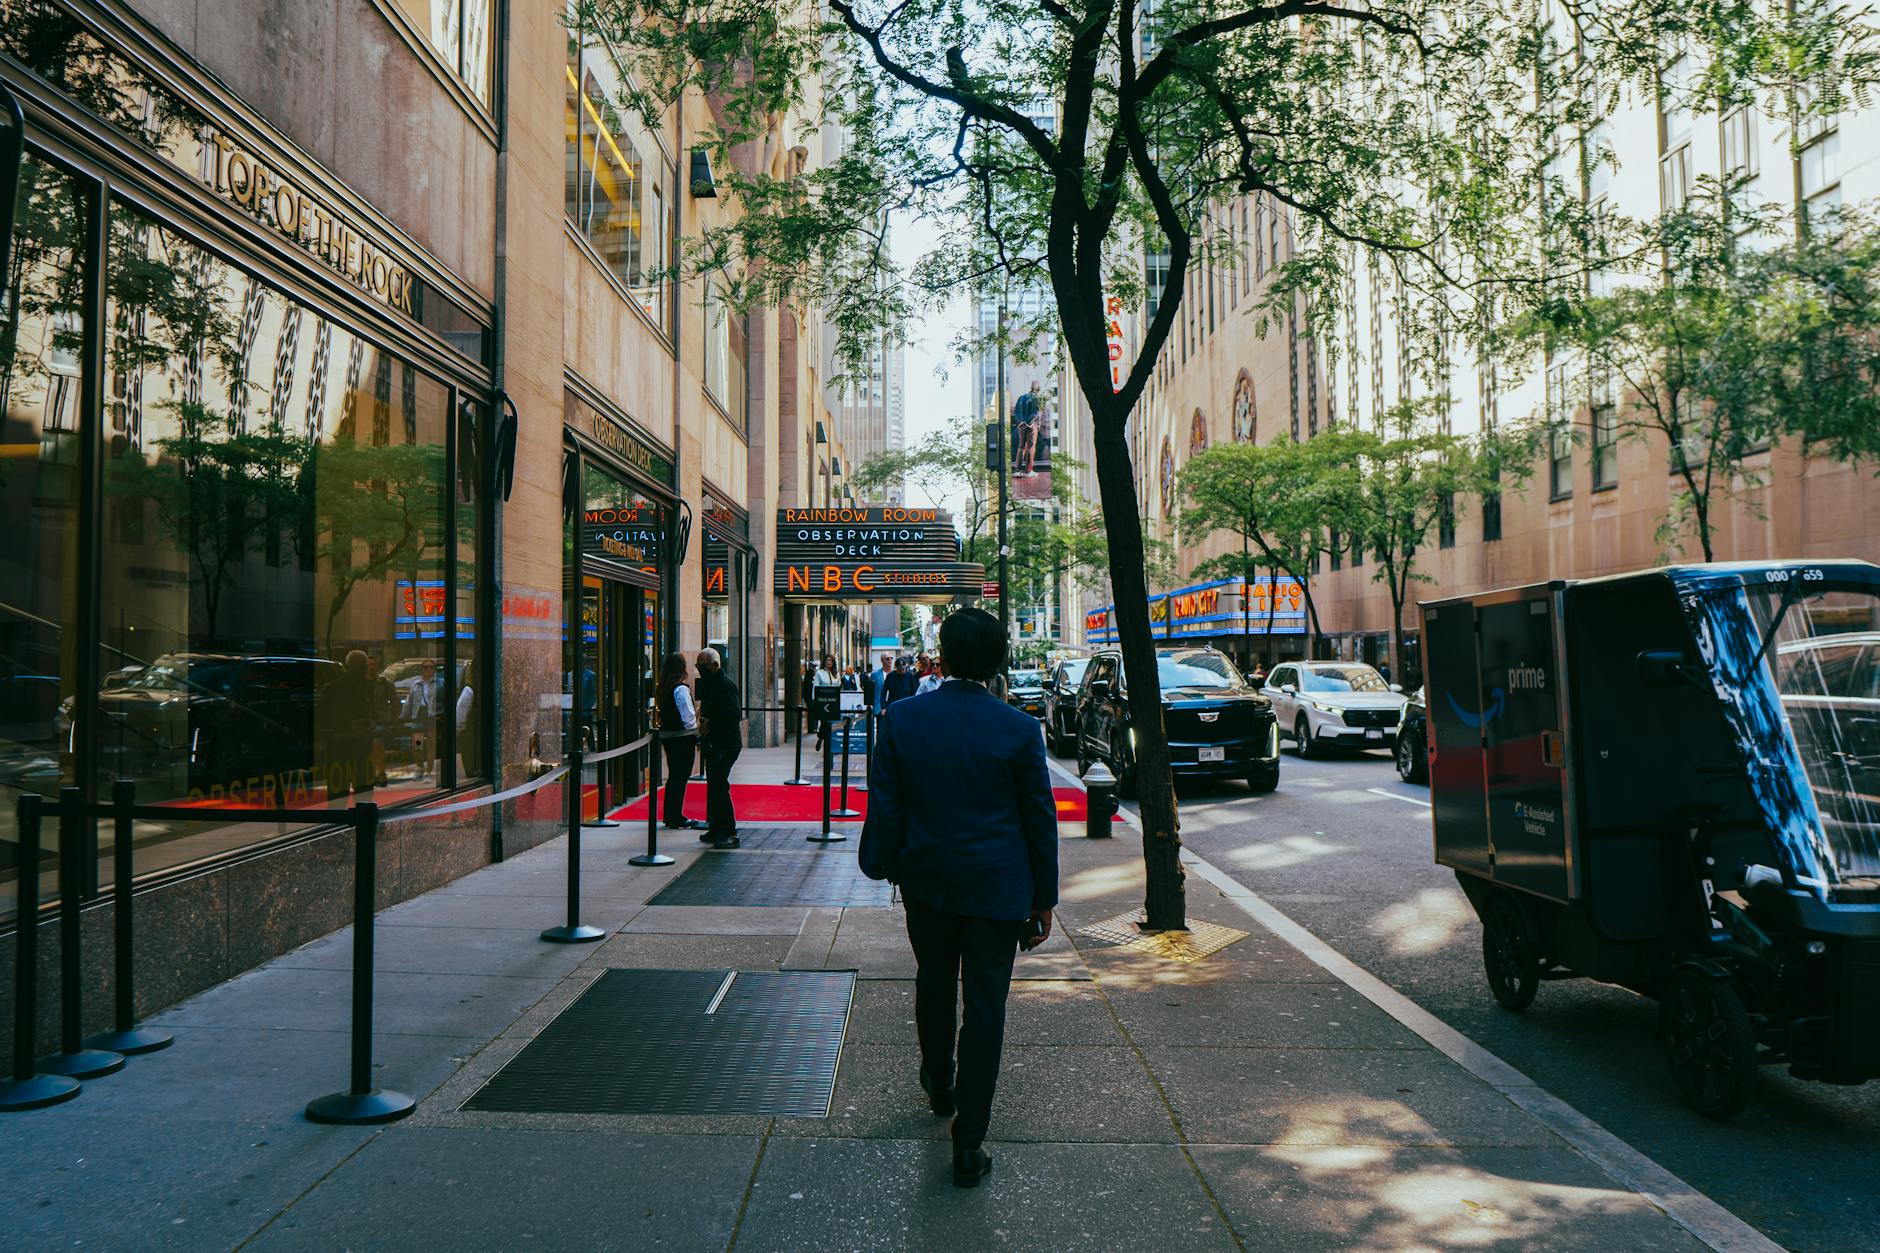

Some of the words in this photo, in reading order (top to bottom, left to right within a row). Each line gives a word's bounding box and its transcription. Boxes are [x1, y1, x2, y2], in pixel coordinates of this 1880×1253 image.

[211, 133, 270, 213] TOP
[275, 186, 310, 241] OF
[314, 208, 356, 276] THE
[361, 247, 413, 315] ROCK
[1107, 297, 1123, 394] RADI
[786, 509, 868, 523] RAINBOW
[883, 508, 936, 522] ROOM
[797, 530, 925, 541] OBSERVATION
[835, 545, 882, 556] DECK
[788, 565, 876, 592] NBC
[884, 573, 948, 584] STUDIOS
[1175, 594, 1197, 618] RADIO
[1198, 589, 1218, 615] CITY
[1508, 661, 1545, 694] prime
